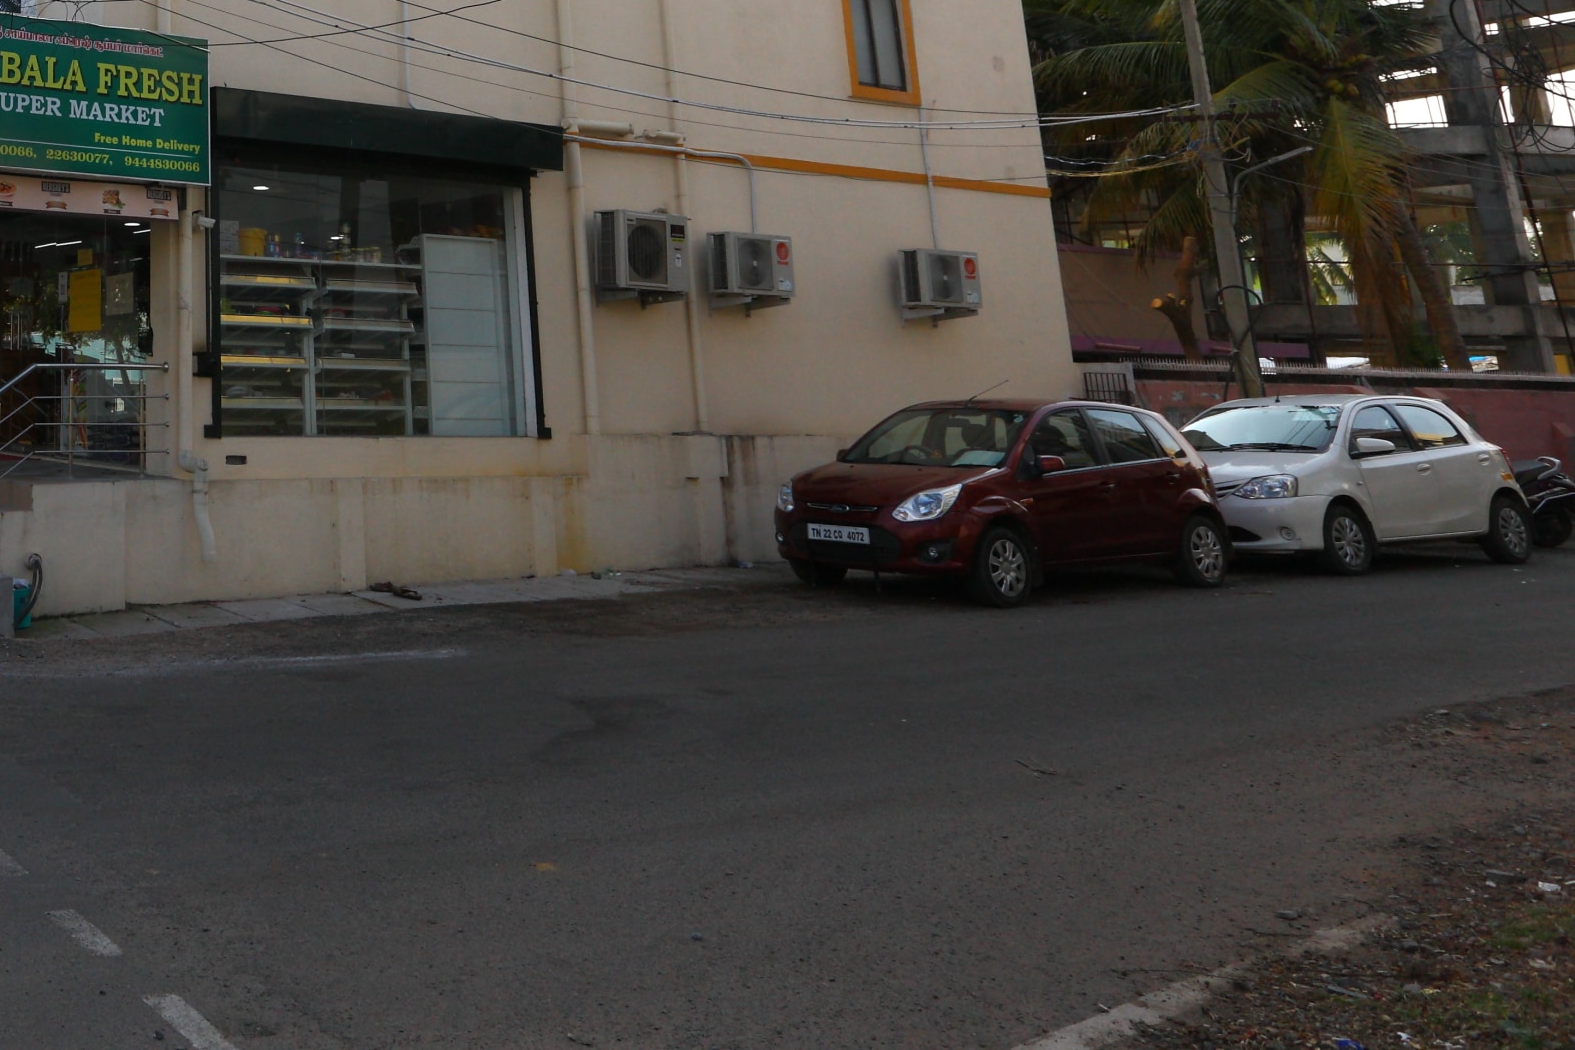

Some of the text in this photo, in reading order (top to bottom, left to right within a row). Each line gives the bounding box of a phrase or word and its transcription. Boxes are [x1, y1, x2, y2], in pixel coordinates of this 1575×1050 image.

[97, 62, 203, 105] FRESH
[69, 99, 164, 127] MARKET
[94, 132, 201, 154] Free Home Delivery
[125, 156, 200, 172] 9444830066
[811, 528, 822, 538] TN
[824, 529, 832, 539] 22
[847, 531, 865, 542] 4072
